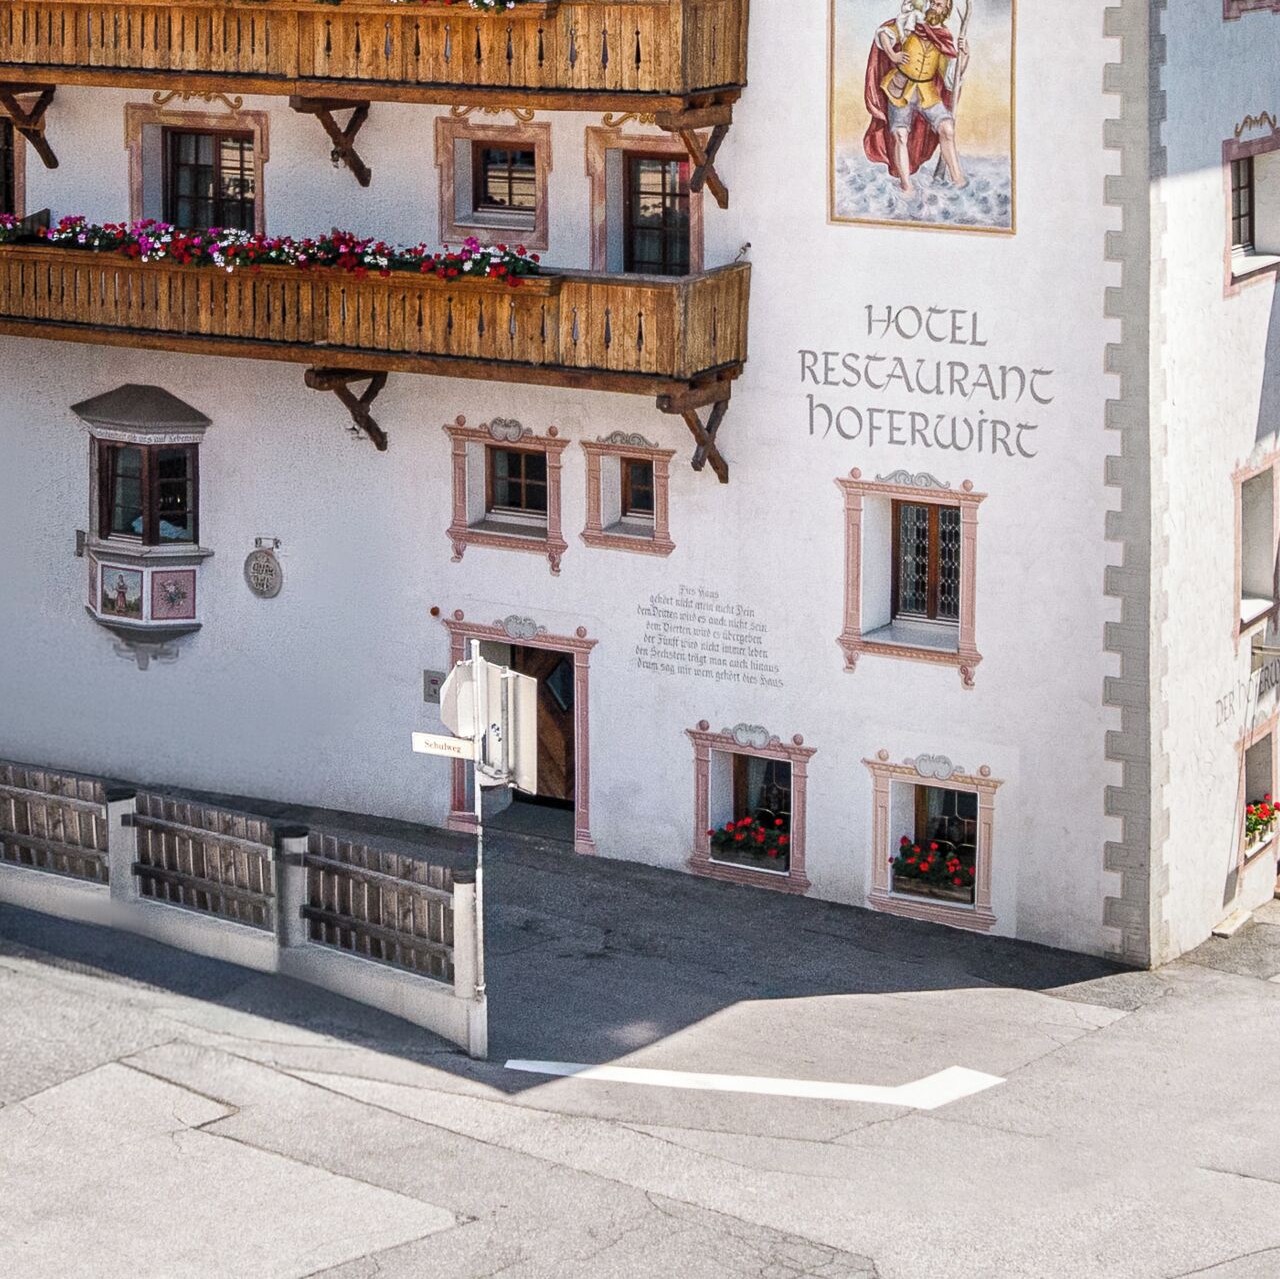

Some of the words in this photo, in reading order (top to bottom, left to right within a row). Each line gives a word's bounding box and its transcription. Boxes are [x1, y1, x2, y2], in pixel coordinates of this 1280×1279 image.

[864, 304, 988, 347] HOTEL
[797, 349, 1055, 404] RESTAURANT
[675, 597, 693, 609] nicht
[715, 604, 734, 614] nicht
[698, 615, 706, 624] es
[728, 617, 748, 629] nicht
[700, 642, 720, 652] nicht
[424, 739, 462, 754] Schulweg
